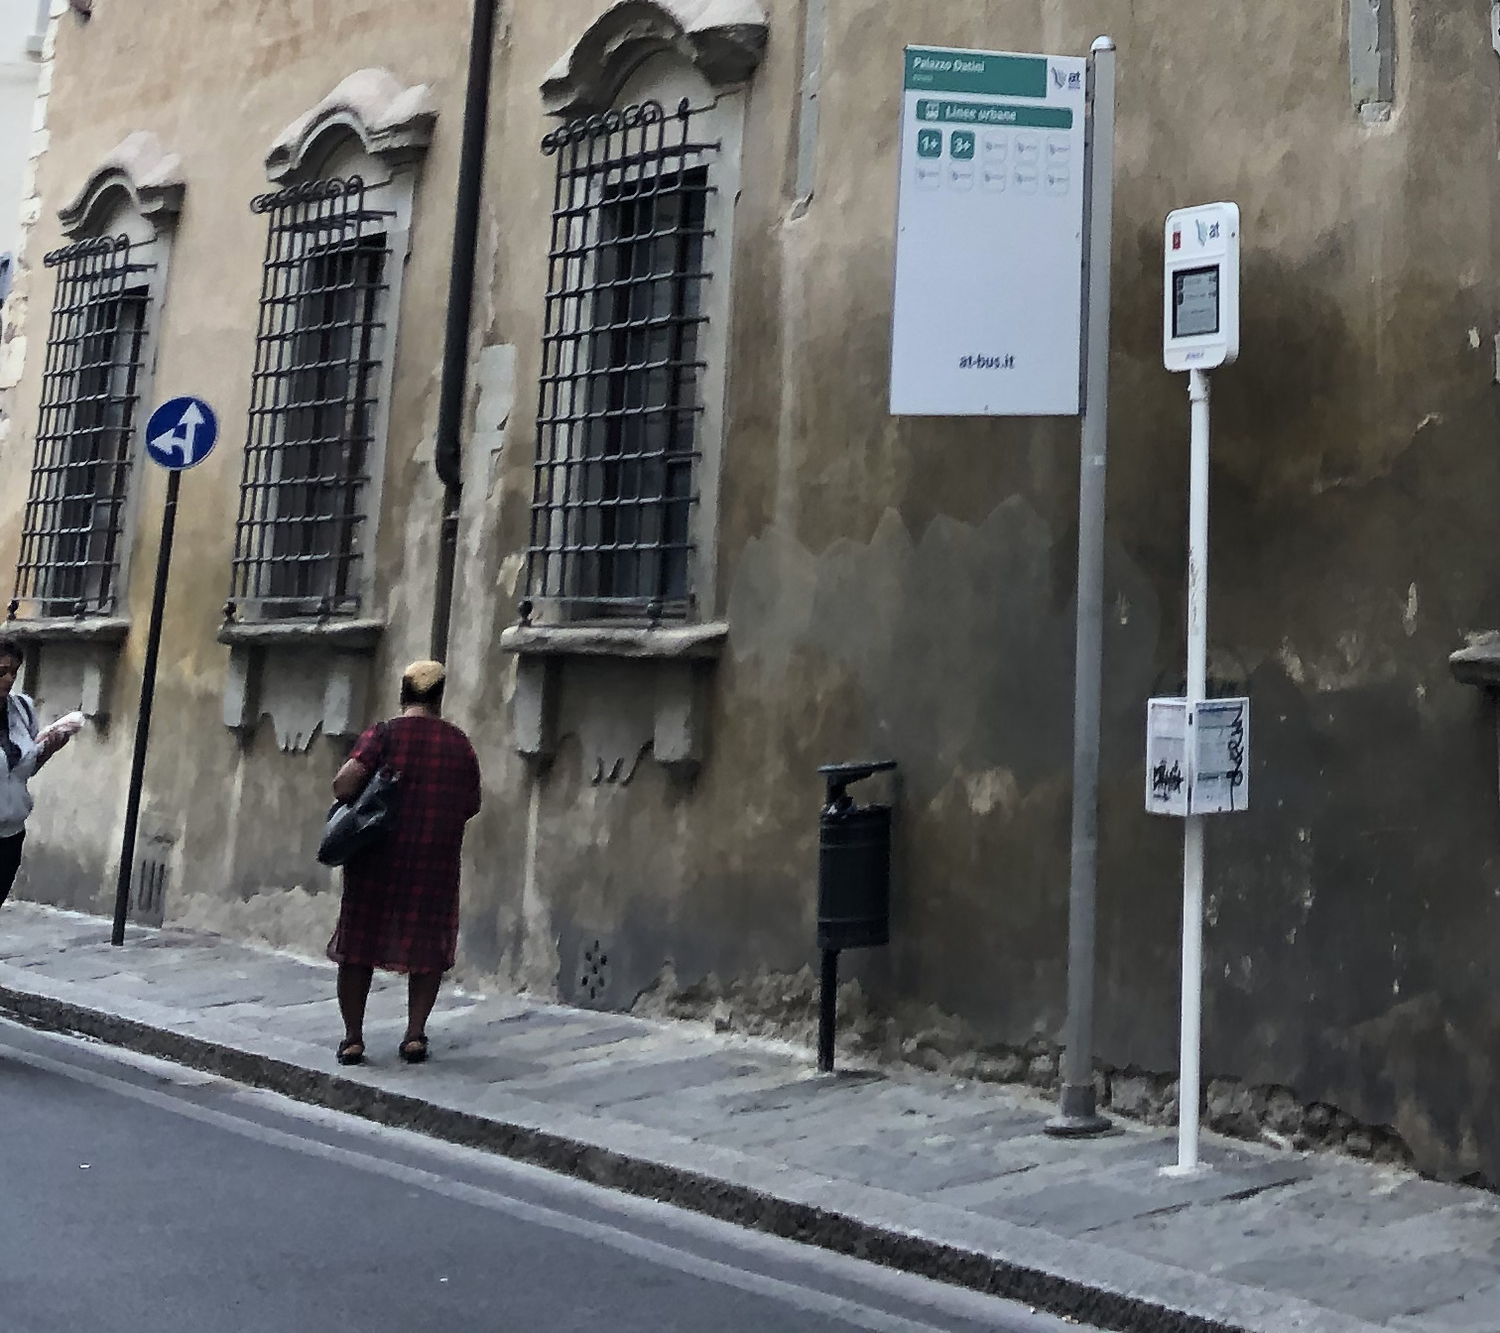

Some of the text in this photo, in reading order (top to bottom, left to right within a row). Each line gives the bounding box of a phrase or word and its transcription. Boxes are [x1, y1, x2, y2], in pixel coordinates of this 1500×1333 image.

[912, 56, 985, 73] Palazzo Datini
[945, 104, 1017, 122] Linee urbane
[959, 353, 1014, 369] at-bus.it
